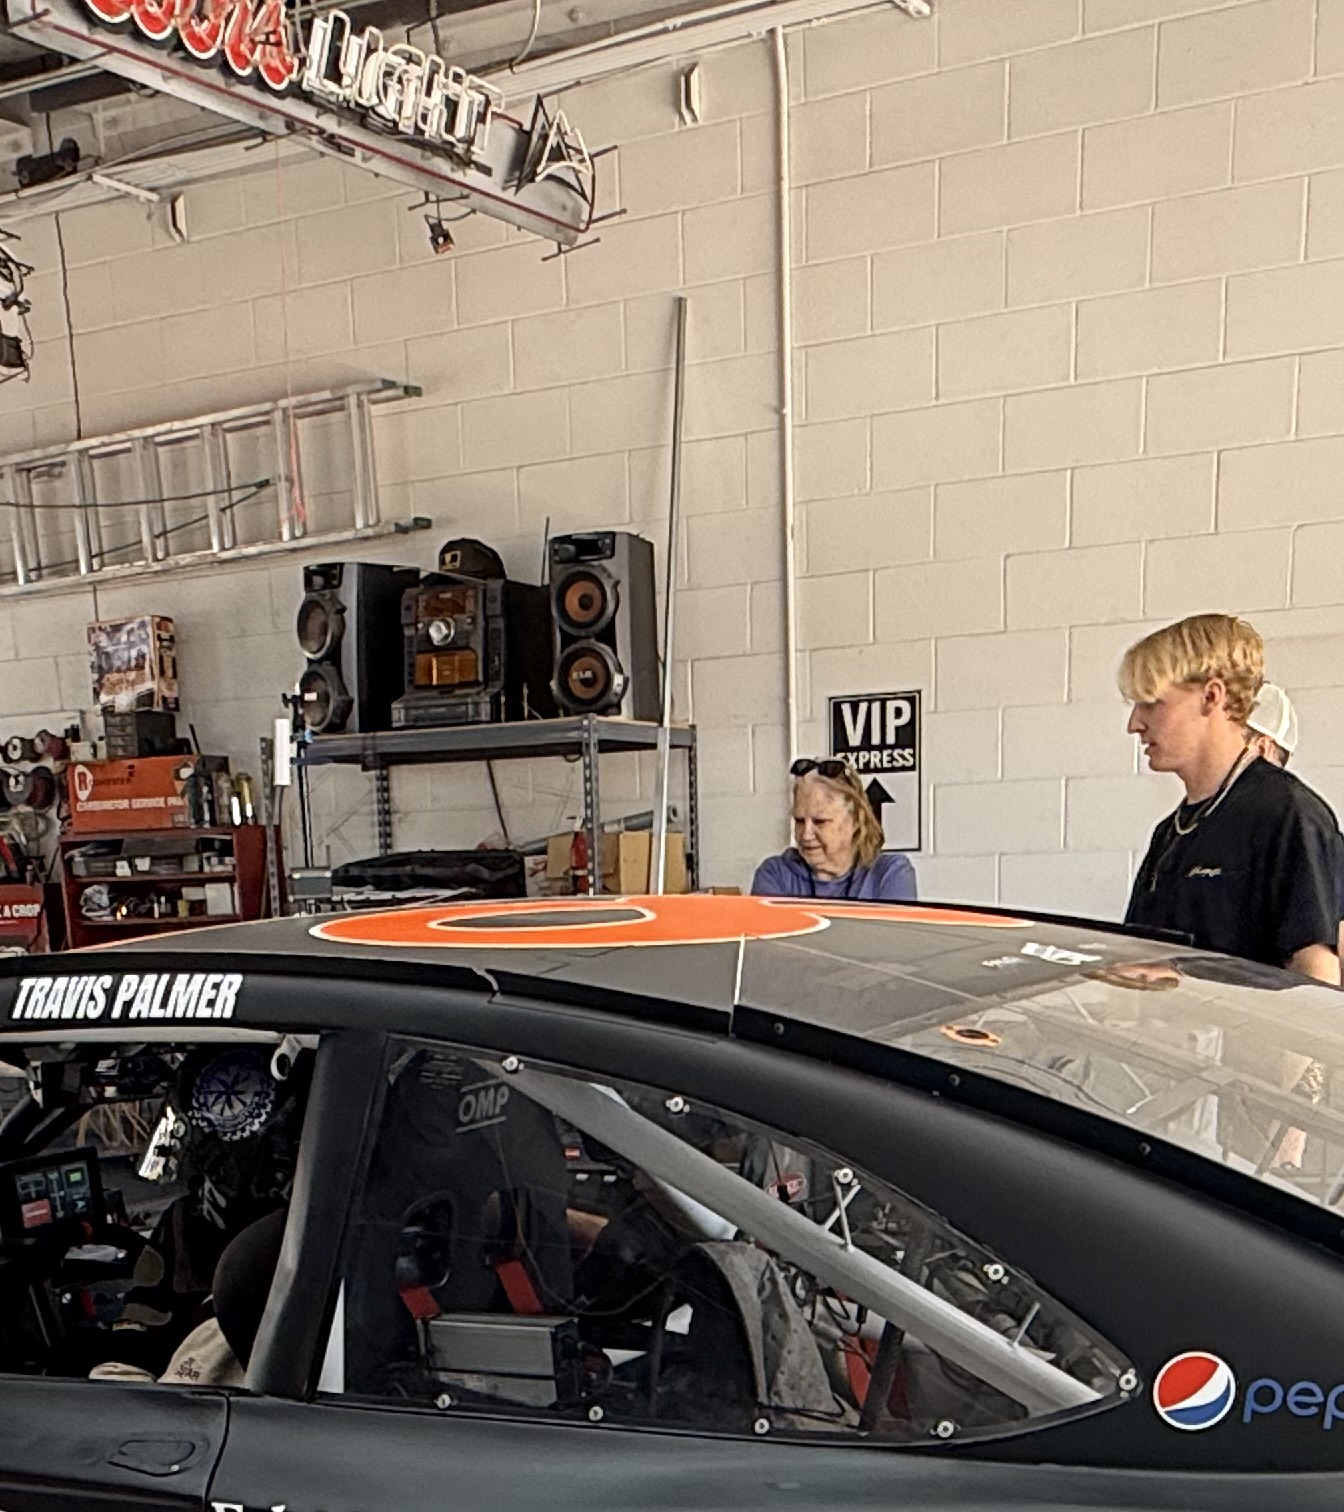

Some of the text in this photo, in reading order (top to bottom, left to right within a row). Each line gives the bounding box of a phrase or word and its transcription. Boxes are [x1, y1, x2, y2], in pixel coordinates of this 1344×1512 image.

[302, 8, 505, 158] LIGHT
[840, 699, 912, 748] VIP
[12, 973, 243, 1019] TRAVIS PALMER
[458, 1086, 510, 1124] OMP
